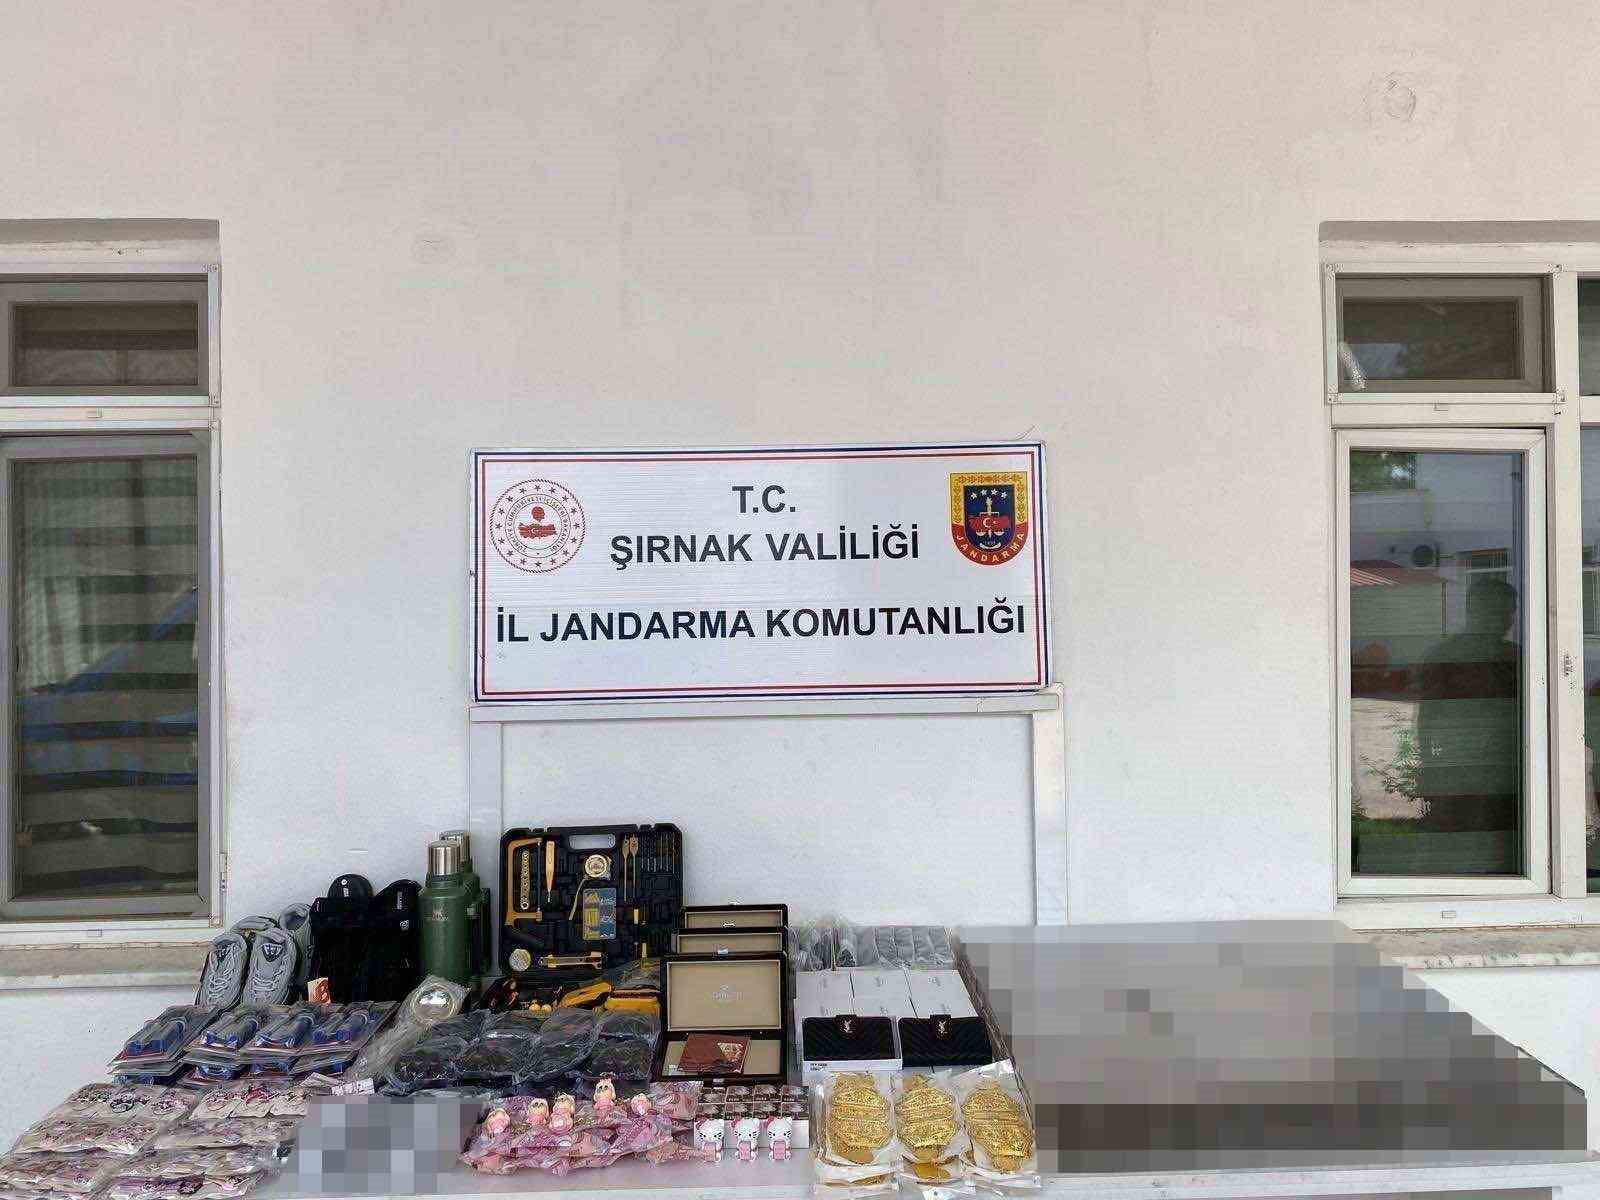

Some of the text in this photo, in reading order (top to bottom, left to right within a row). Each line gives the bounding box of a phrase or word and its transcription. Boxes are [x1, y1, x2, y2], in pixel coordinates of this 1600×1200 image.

[731, 485, 796, 514] T.C.
[610, 523, 919, 571] ŞIRNAK VALİLİĞİ
[956, 534, 1025, 562] JANDARMA
[497, 596, 1025, 643] İL JANDARMA KOMUTANLIĞI
